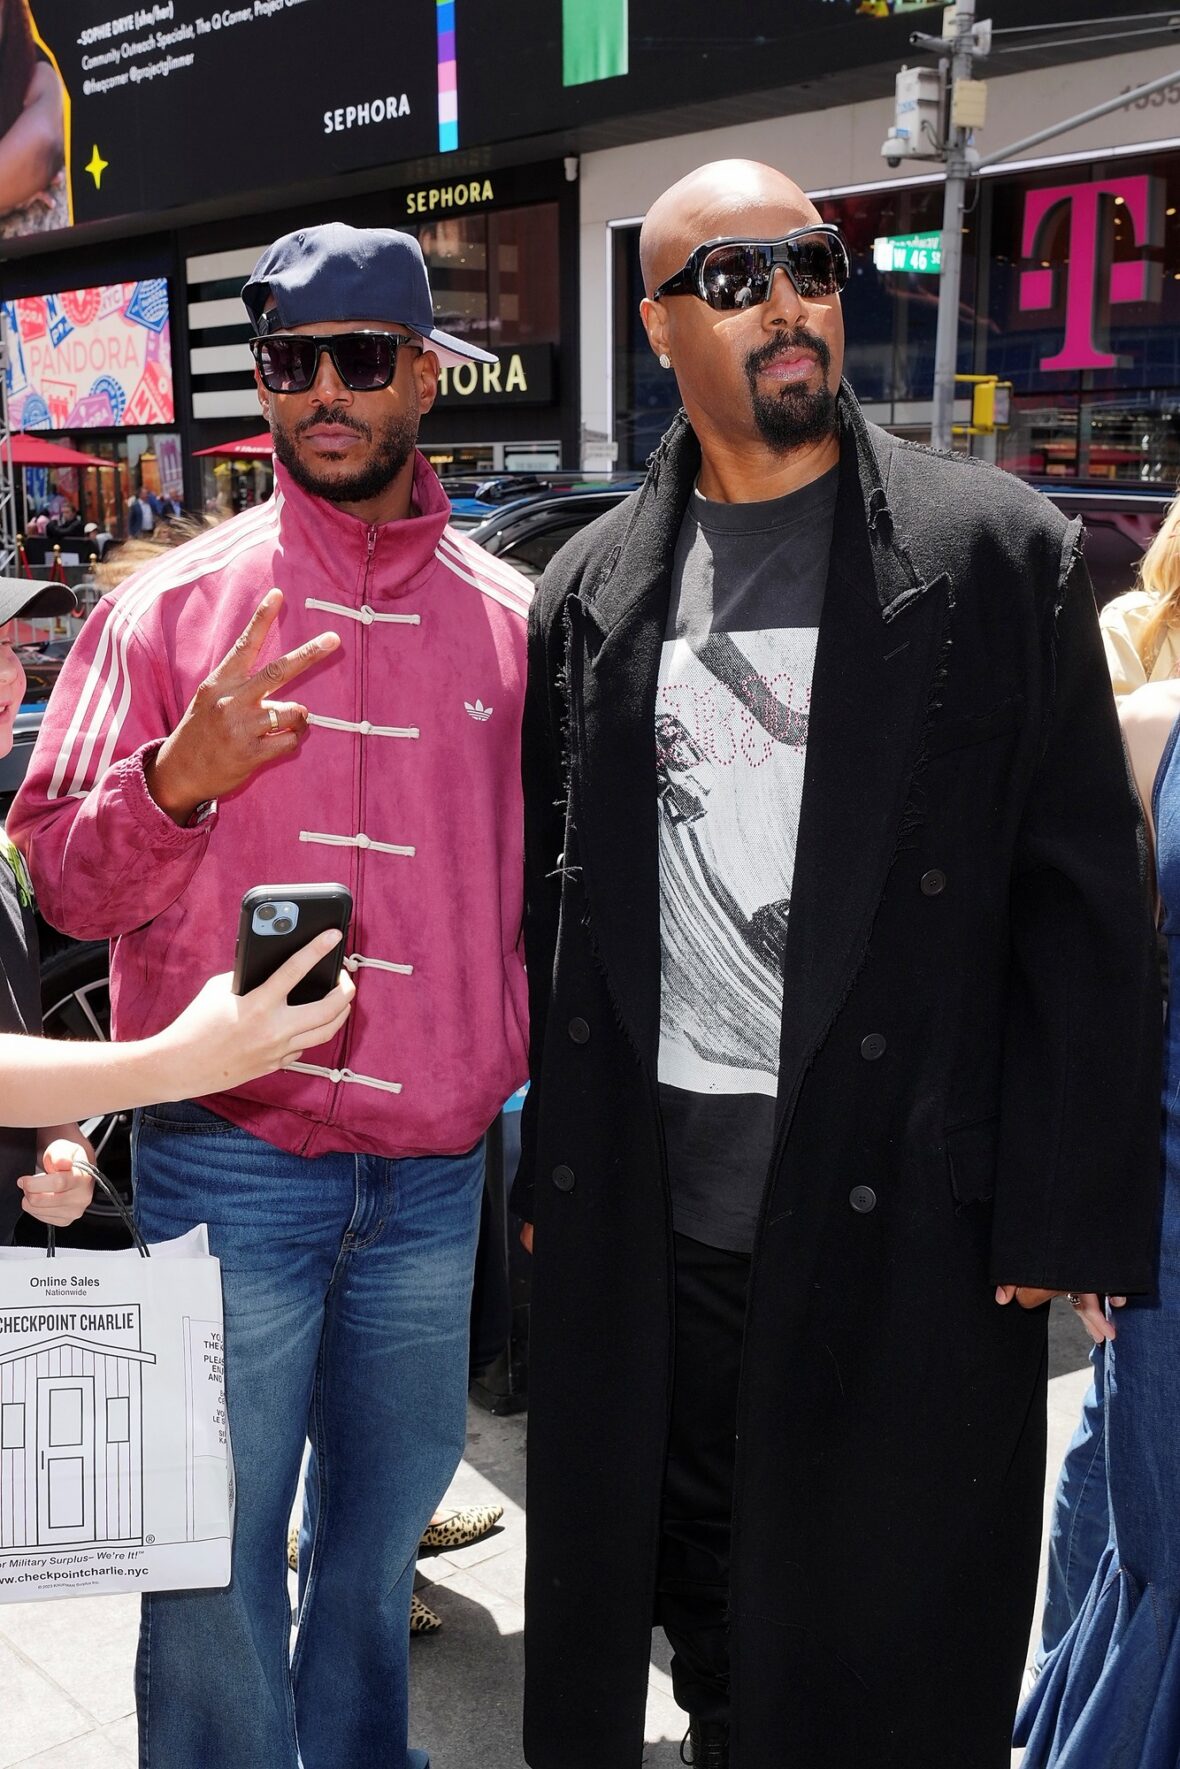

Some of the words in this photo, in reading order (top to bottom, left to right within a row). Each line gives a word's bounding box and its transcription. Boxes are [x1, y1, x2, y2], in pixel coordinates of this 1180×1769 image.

[82, 48, 120, 70] Community
[121, 34, 156, 58] Outreach
[195, 17, 211, 35] The
[324, 93, 411, 134] SEPHORA
[406, 180, 494, 214] SEPHORA
[893, 248, 907, 269] W
[909, 249, 928, 270] 46
[1019, 174, 1150, 372] T
[29, 335, 140, 377] PANDORA
[30, 1276, 67, 1287] Online
[70, 1276, 100, 1287] Sales
[80, 1312, 134, 1331] CHARLIE
[9, 1558, 47, 1568] Military
